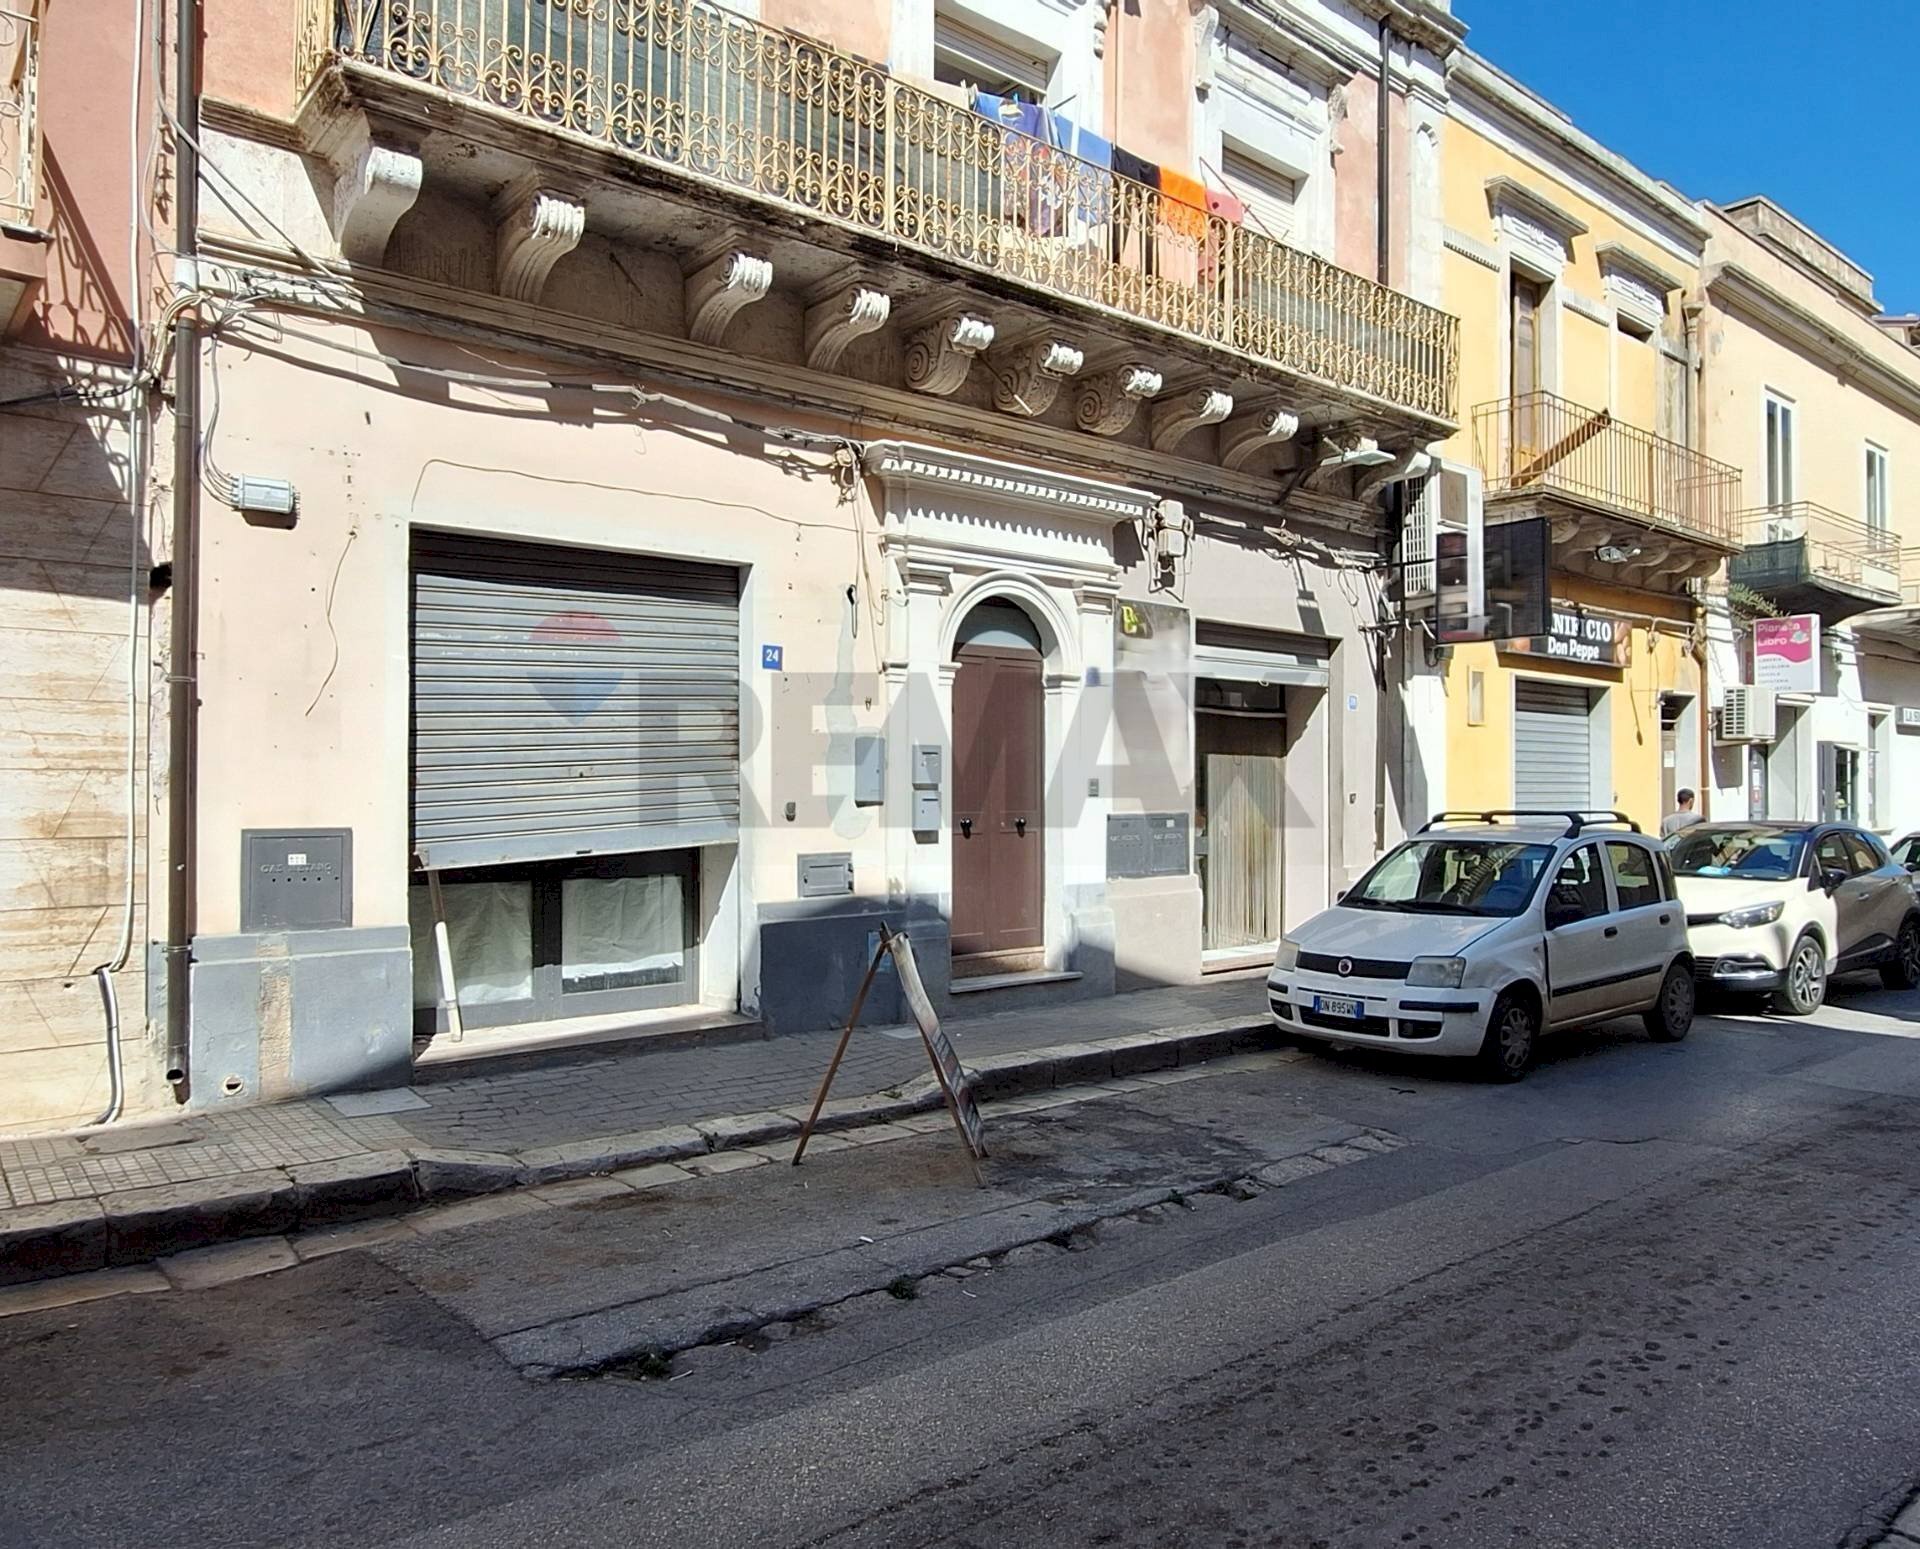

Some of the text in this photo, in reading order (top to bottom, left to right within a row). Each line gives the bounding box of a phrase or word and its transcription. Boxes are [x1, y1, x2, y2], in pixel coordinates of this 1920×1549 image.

[1551, 613, 1612, 643] NIFICIO
[766, 649, 779, 662] 24
[1548, 635, 1600, 661] Don Peppe
